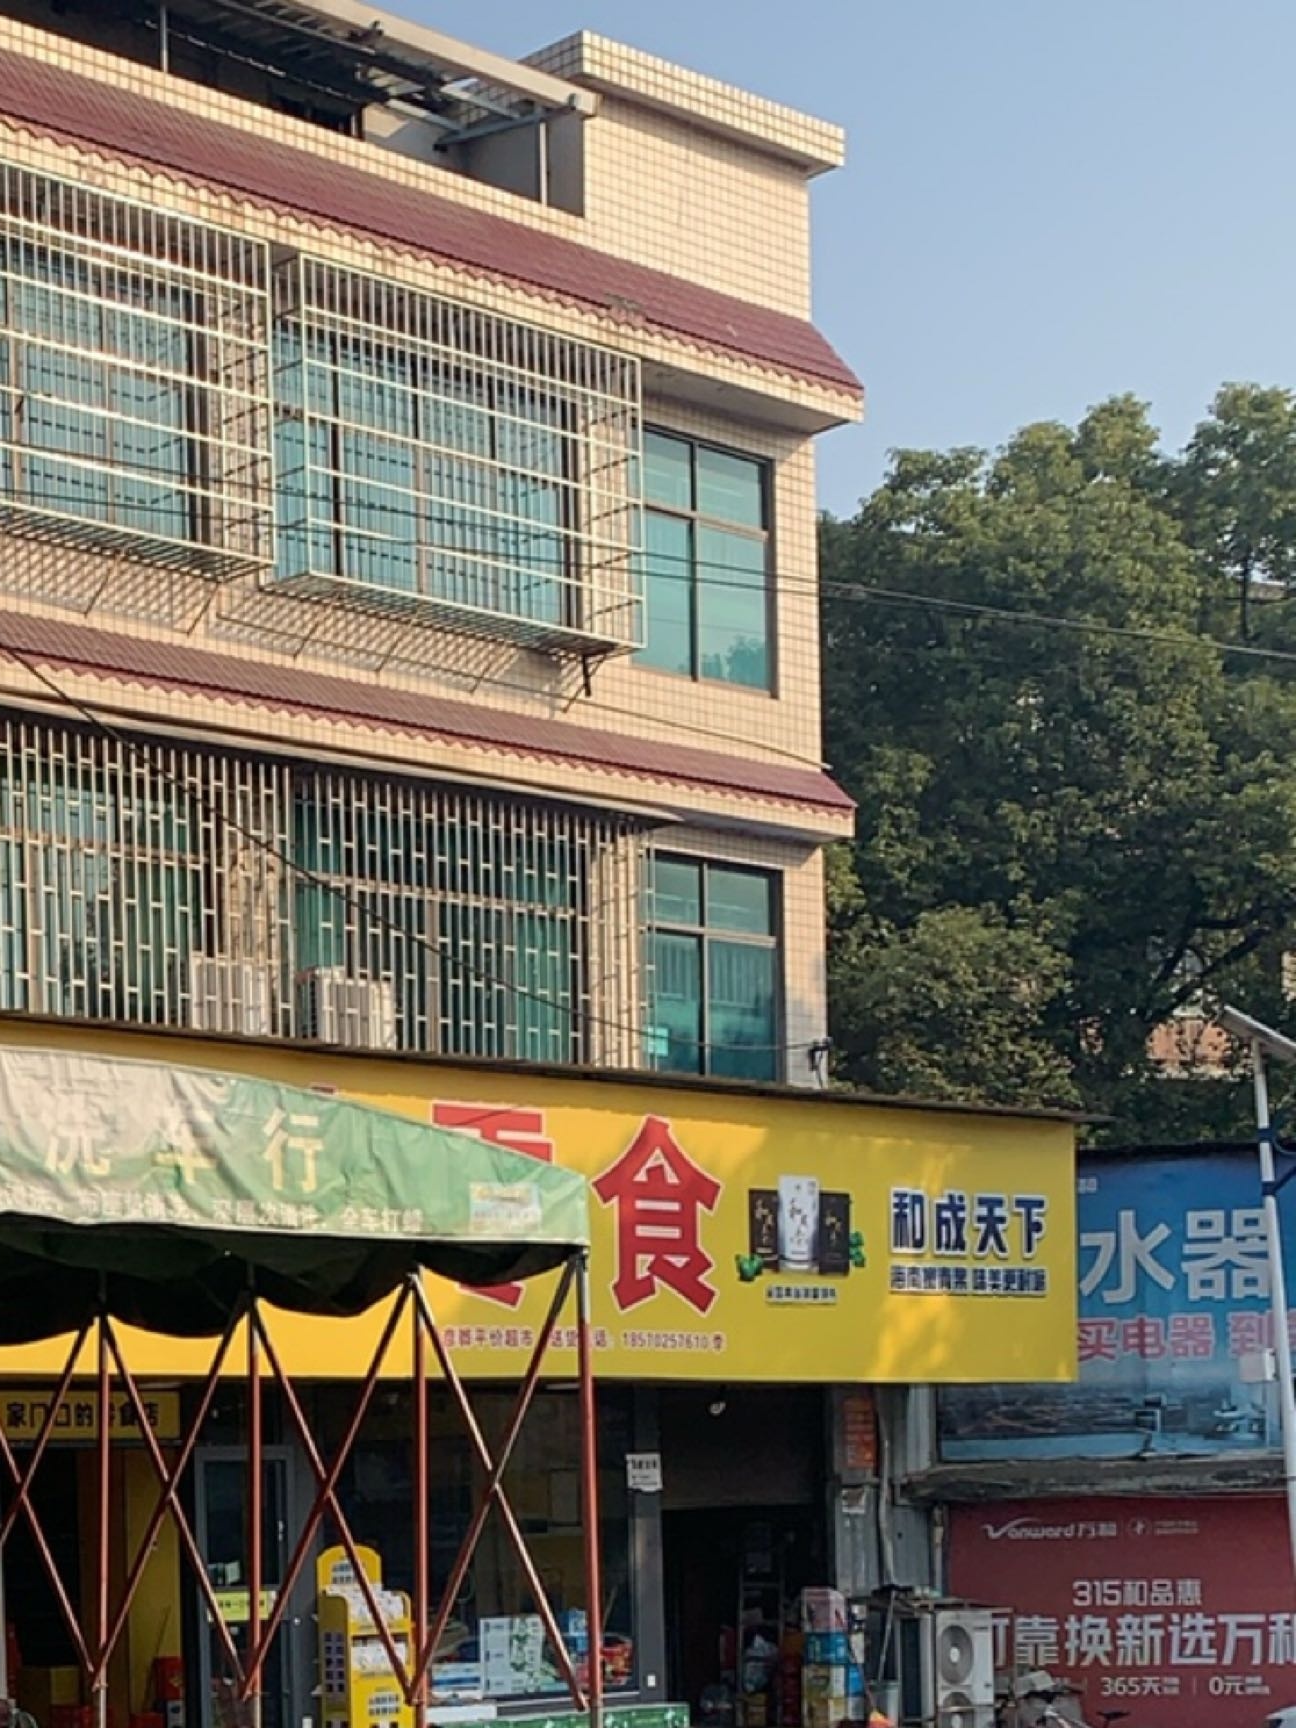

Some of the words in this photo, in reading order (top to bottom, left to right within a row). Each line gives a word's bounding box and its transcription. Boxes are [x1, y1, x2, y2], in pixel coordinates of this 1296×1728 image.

[890, 1188, 1047, 1257] 和成天下
[1079, 1209, 1270, 1303] 水器
[1078, 1313, 1215, 1362] 买电器
[6, 1402, 160, 1428] 家门口的食店
[1072, 1579, 1202, 1607] 315和品惠
